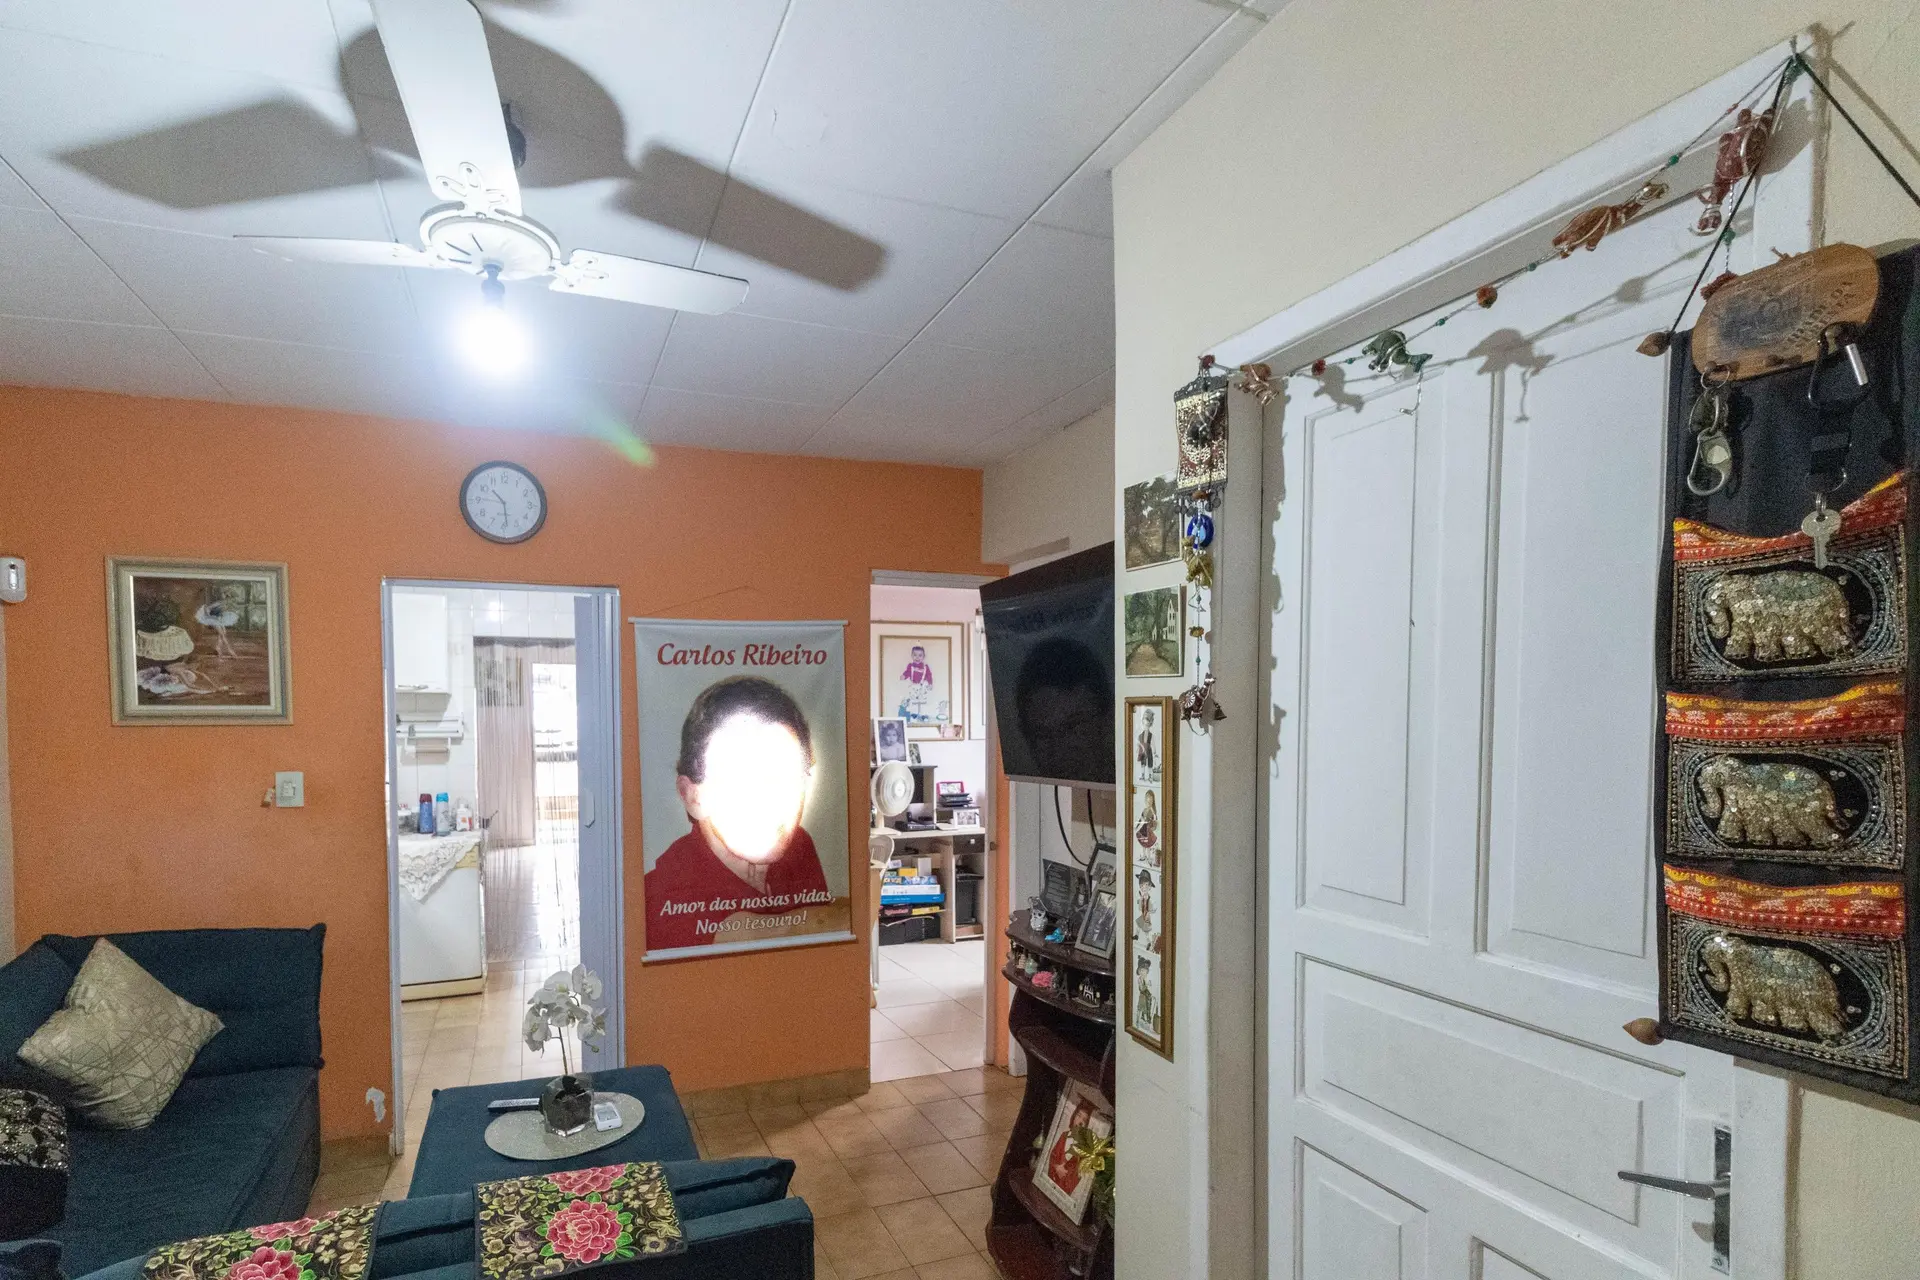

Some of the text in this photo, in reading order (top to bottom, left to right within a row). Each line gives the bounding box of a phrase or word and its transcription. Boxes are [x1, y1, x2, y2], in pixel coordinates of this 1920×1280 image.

[657, 642, 828, 666] Carlos Ribeiro
[660, 889, 836, 917] Amor das nossas vidas,
[695, 910, 807, 936] Nosso tesouro!
